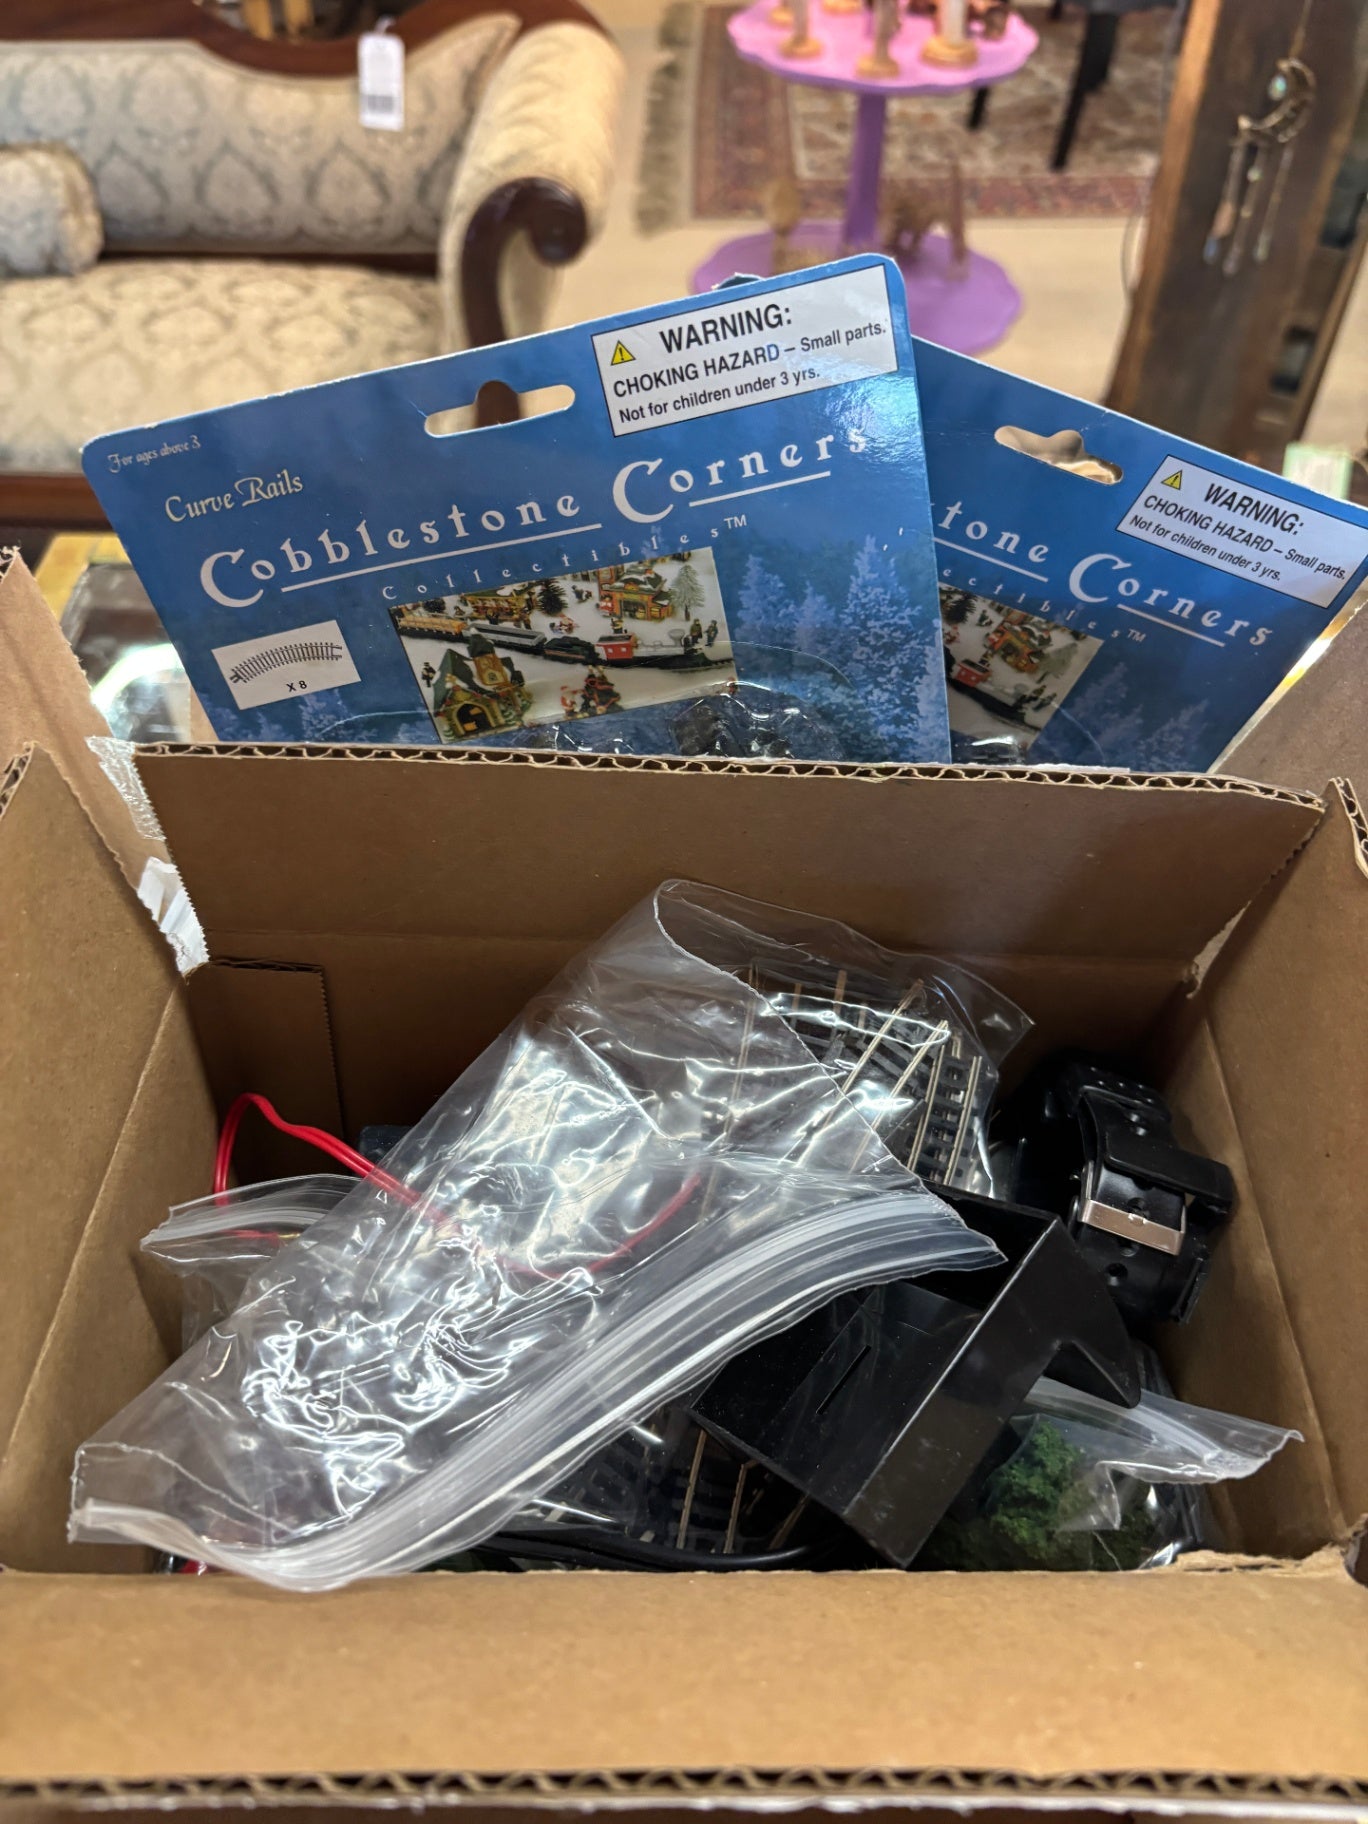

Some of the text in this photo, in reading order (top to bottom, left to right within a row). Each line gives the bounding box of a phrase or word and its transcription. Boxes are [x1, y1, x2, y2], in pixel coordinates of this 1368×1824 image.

[612, 362, 700, 398] CHOKING
[702, 343, 781, 377] HAZARD
[800, 330, 842, 352] Small
[845, 321, 888, 344] parts.
[659, 303, 793, 354] WARNING:
[619, 366, 821, 423] Not for children under 3 yrs.
[107, 452, 134, 473] For
[136, 449, 159, 466] ages
[160, 442, 190, 457] above
[165, 468, 304, 523] Curve Rails
[200, 430, 868, 608] Cobblestone Corners
[1204, 483, 1304, 536] WARNING:
[382, 528, 720, 600] Collectibles
[1129, 514, 1281, 584] Not for children under 3 yrs.
[1143, 495, 1213, 531] CHOKING
[1212, 521, 1274, 553] HAZARD
[1284, 549, 1318, 569] Small
[1316, 562, 1347, 580] parts.
[930, 501, 1274, 646] tone Corners
[942, 568, 1121, 639] ectibles
[286, 679, 308, 692] X 8
